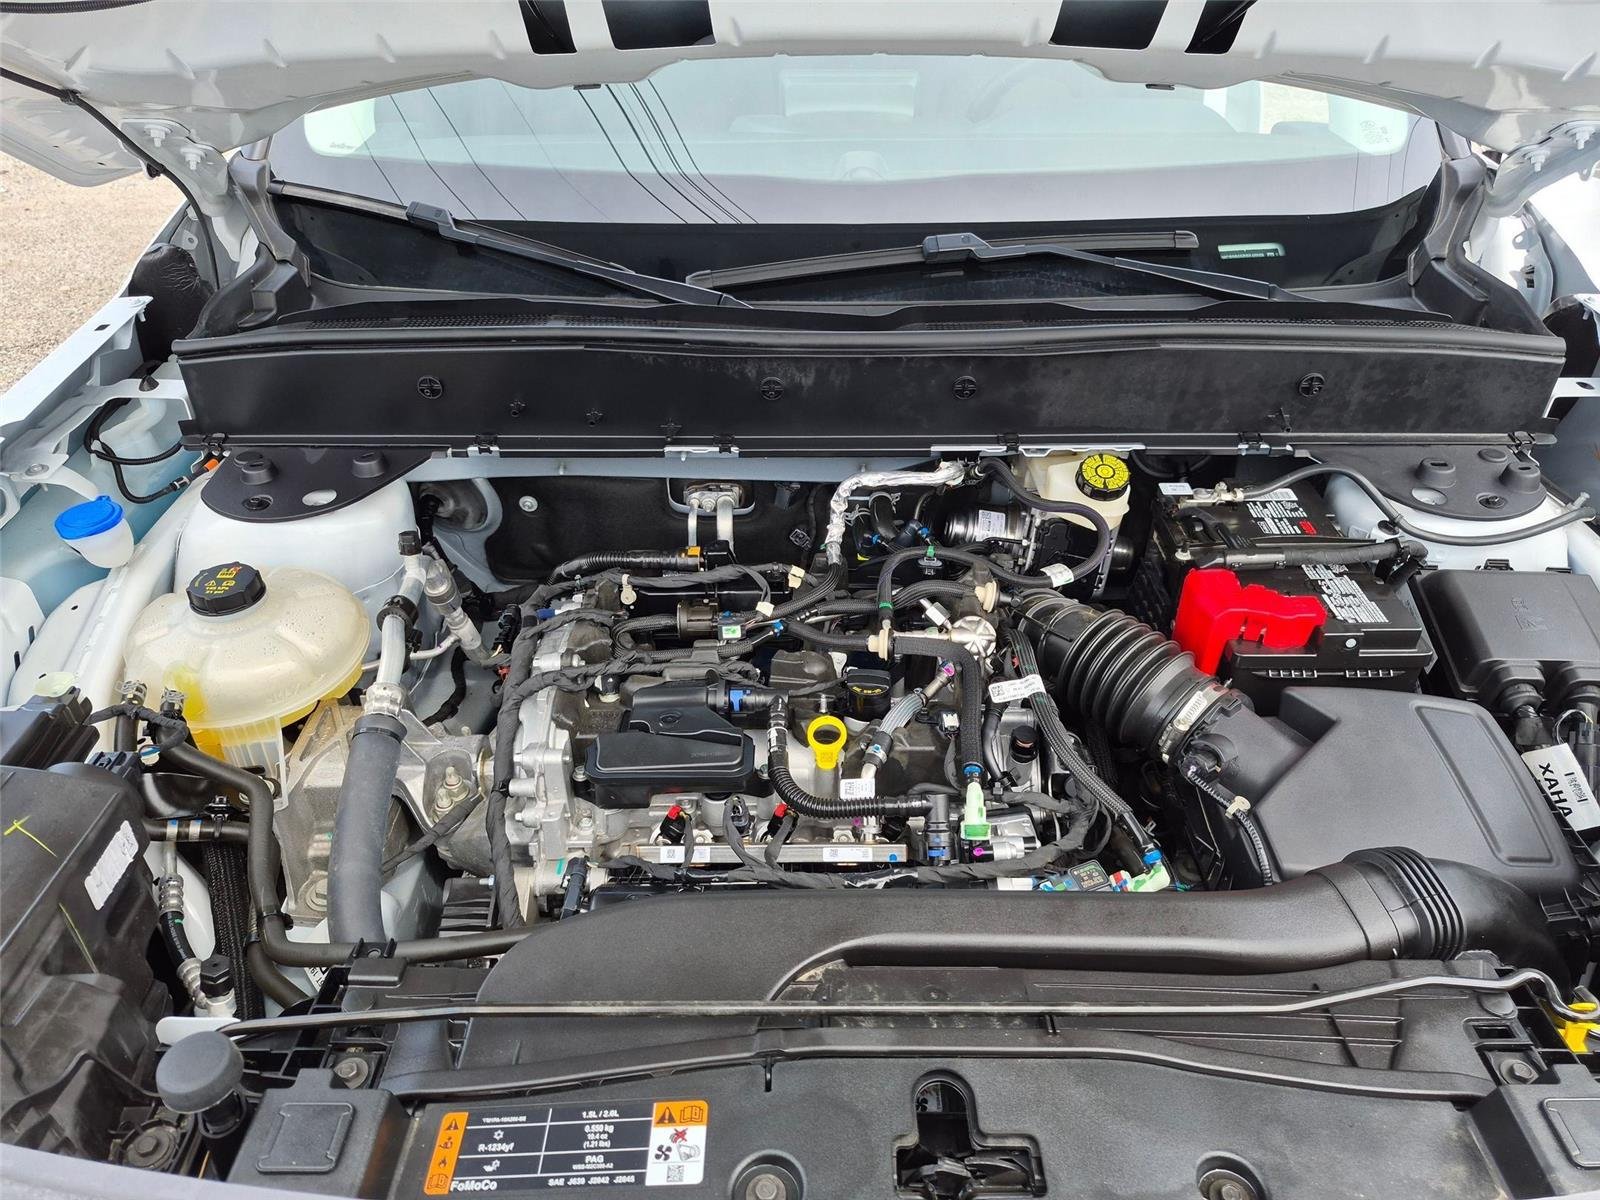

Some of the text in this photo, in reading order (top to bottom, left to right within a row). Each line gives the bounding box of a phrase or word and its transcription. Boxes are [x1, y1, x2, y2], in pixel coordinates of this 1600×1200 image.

[1539, 762, 1573, 818] XAHA
[605, 1124, 614, 1133] kg
[478, 1142, 515, 1153] R-1234yf
[585, 1154, 604, 1163] PAG
[450, 1179, 498, 1192] FoMoCo
